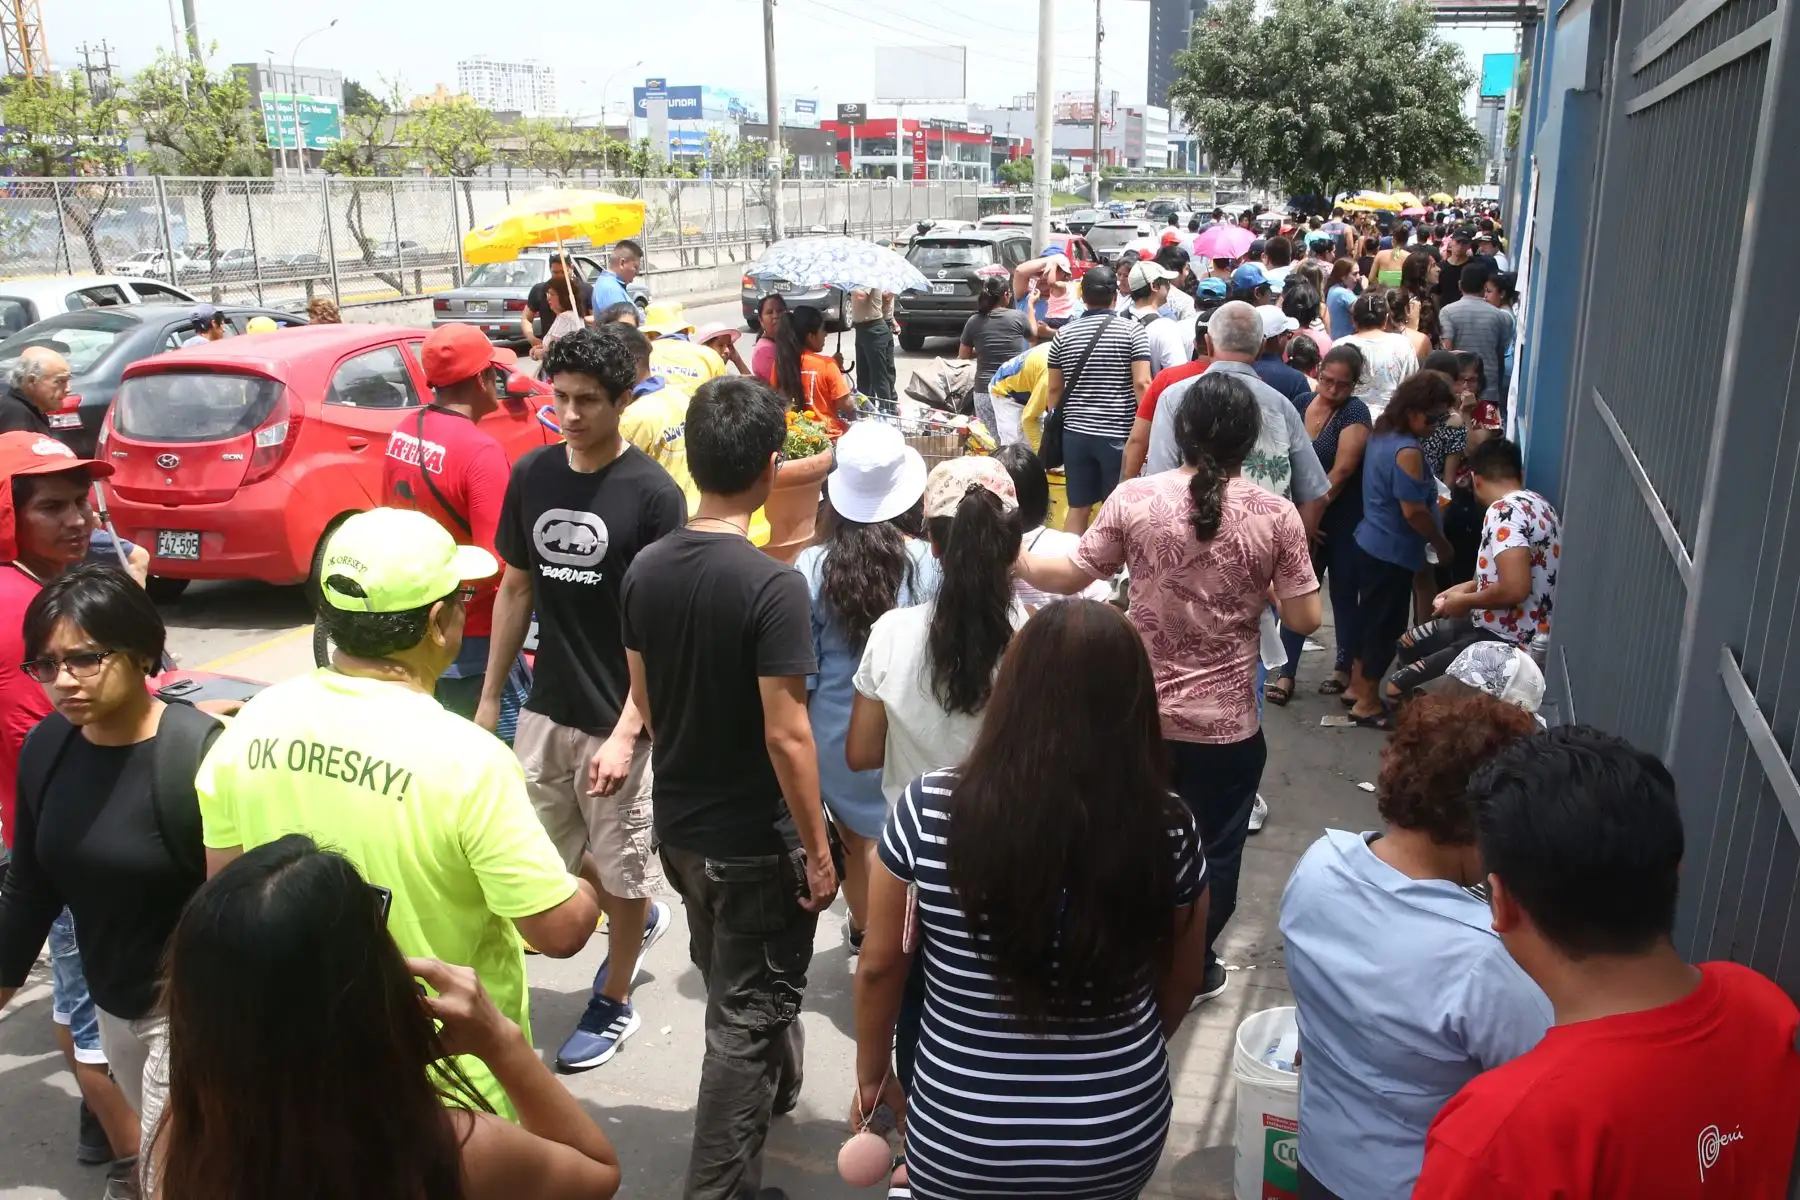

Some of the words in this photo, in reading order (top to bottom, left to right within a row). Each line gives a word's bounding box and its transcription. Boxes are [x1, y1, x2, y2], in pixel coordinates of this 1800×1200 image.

[667, 98, 697, 108] UNDAI
[159, 537, 198, 555] F4Z-595
[248, 738, 279, 770] OK
[287, 739, 413, 802] ORESKY!
[1278, 1142, 1298, 1162] Co
[1698, 1124, 1744, 1183] Perú
